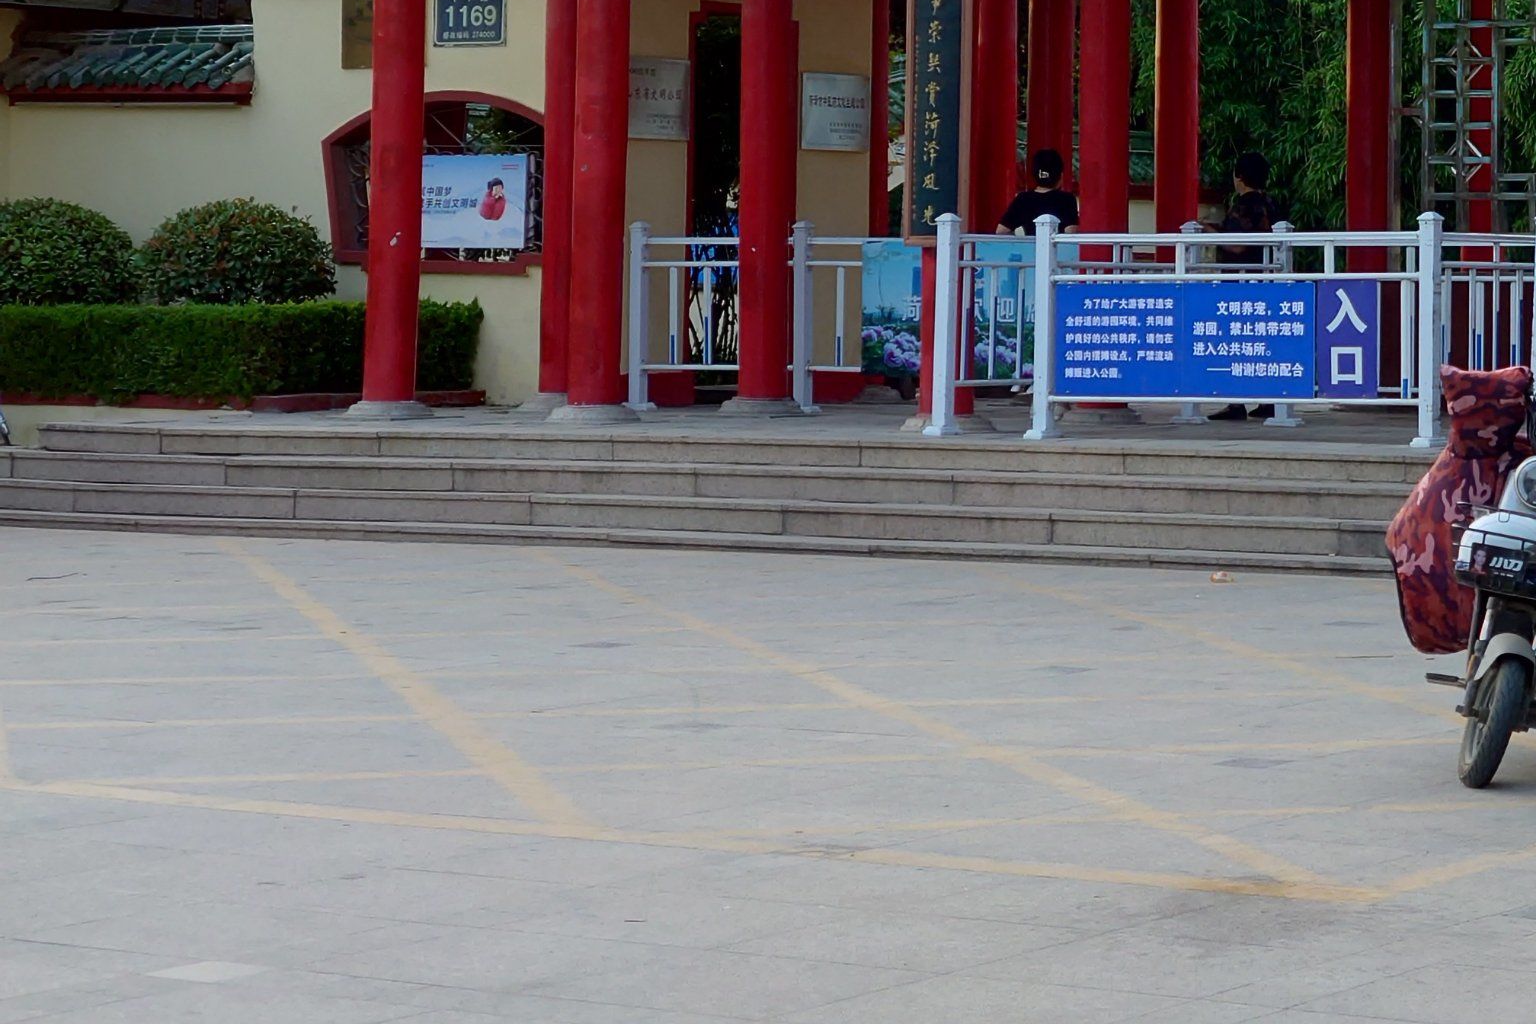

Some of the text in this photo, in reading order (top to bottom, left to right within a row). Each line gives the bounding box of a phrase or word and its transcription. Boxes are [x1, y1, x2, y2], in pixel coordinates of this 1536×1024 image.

[445, 5, 497, 28] 1169
[1217, 301, 1304, 316] 文明养宠，文明
[1193, 322, 1304, 336] 游园，禁止携带宠物
[1326, 288, 1368, 385] 入口
[1193, 342, 1272, 357] 进入公共场所。
